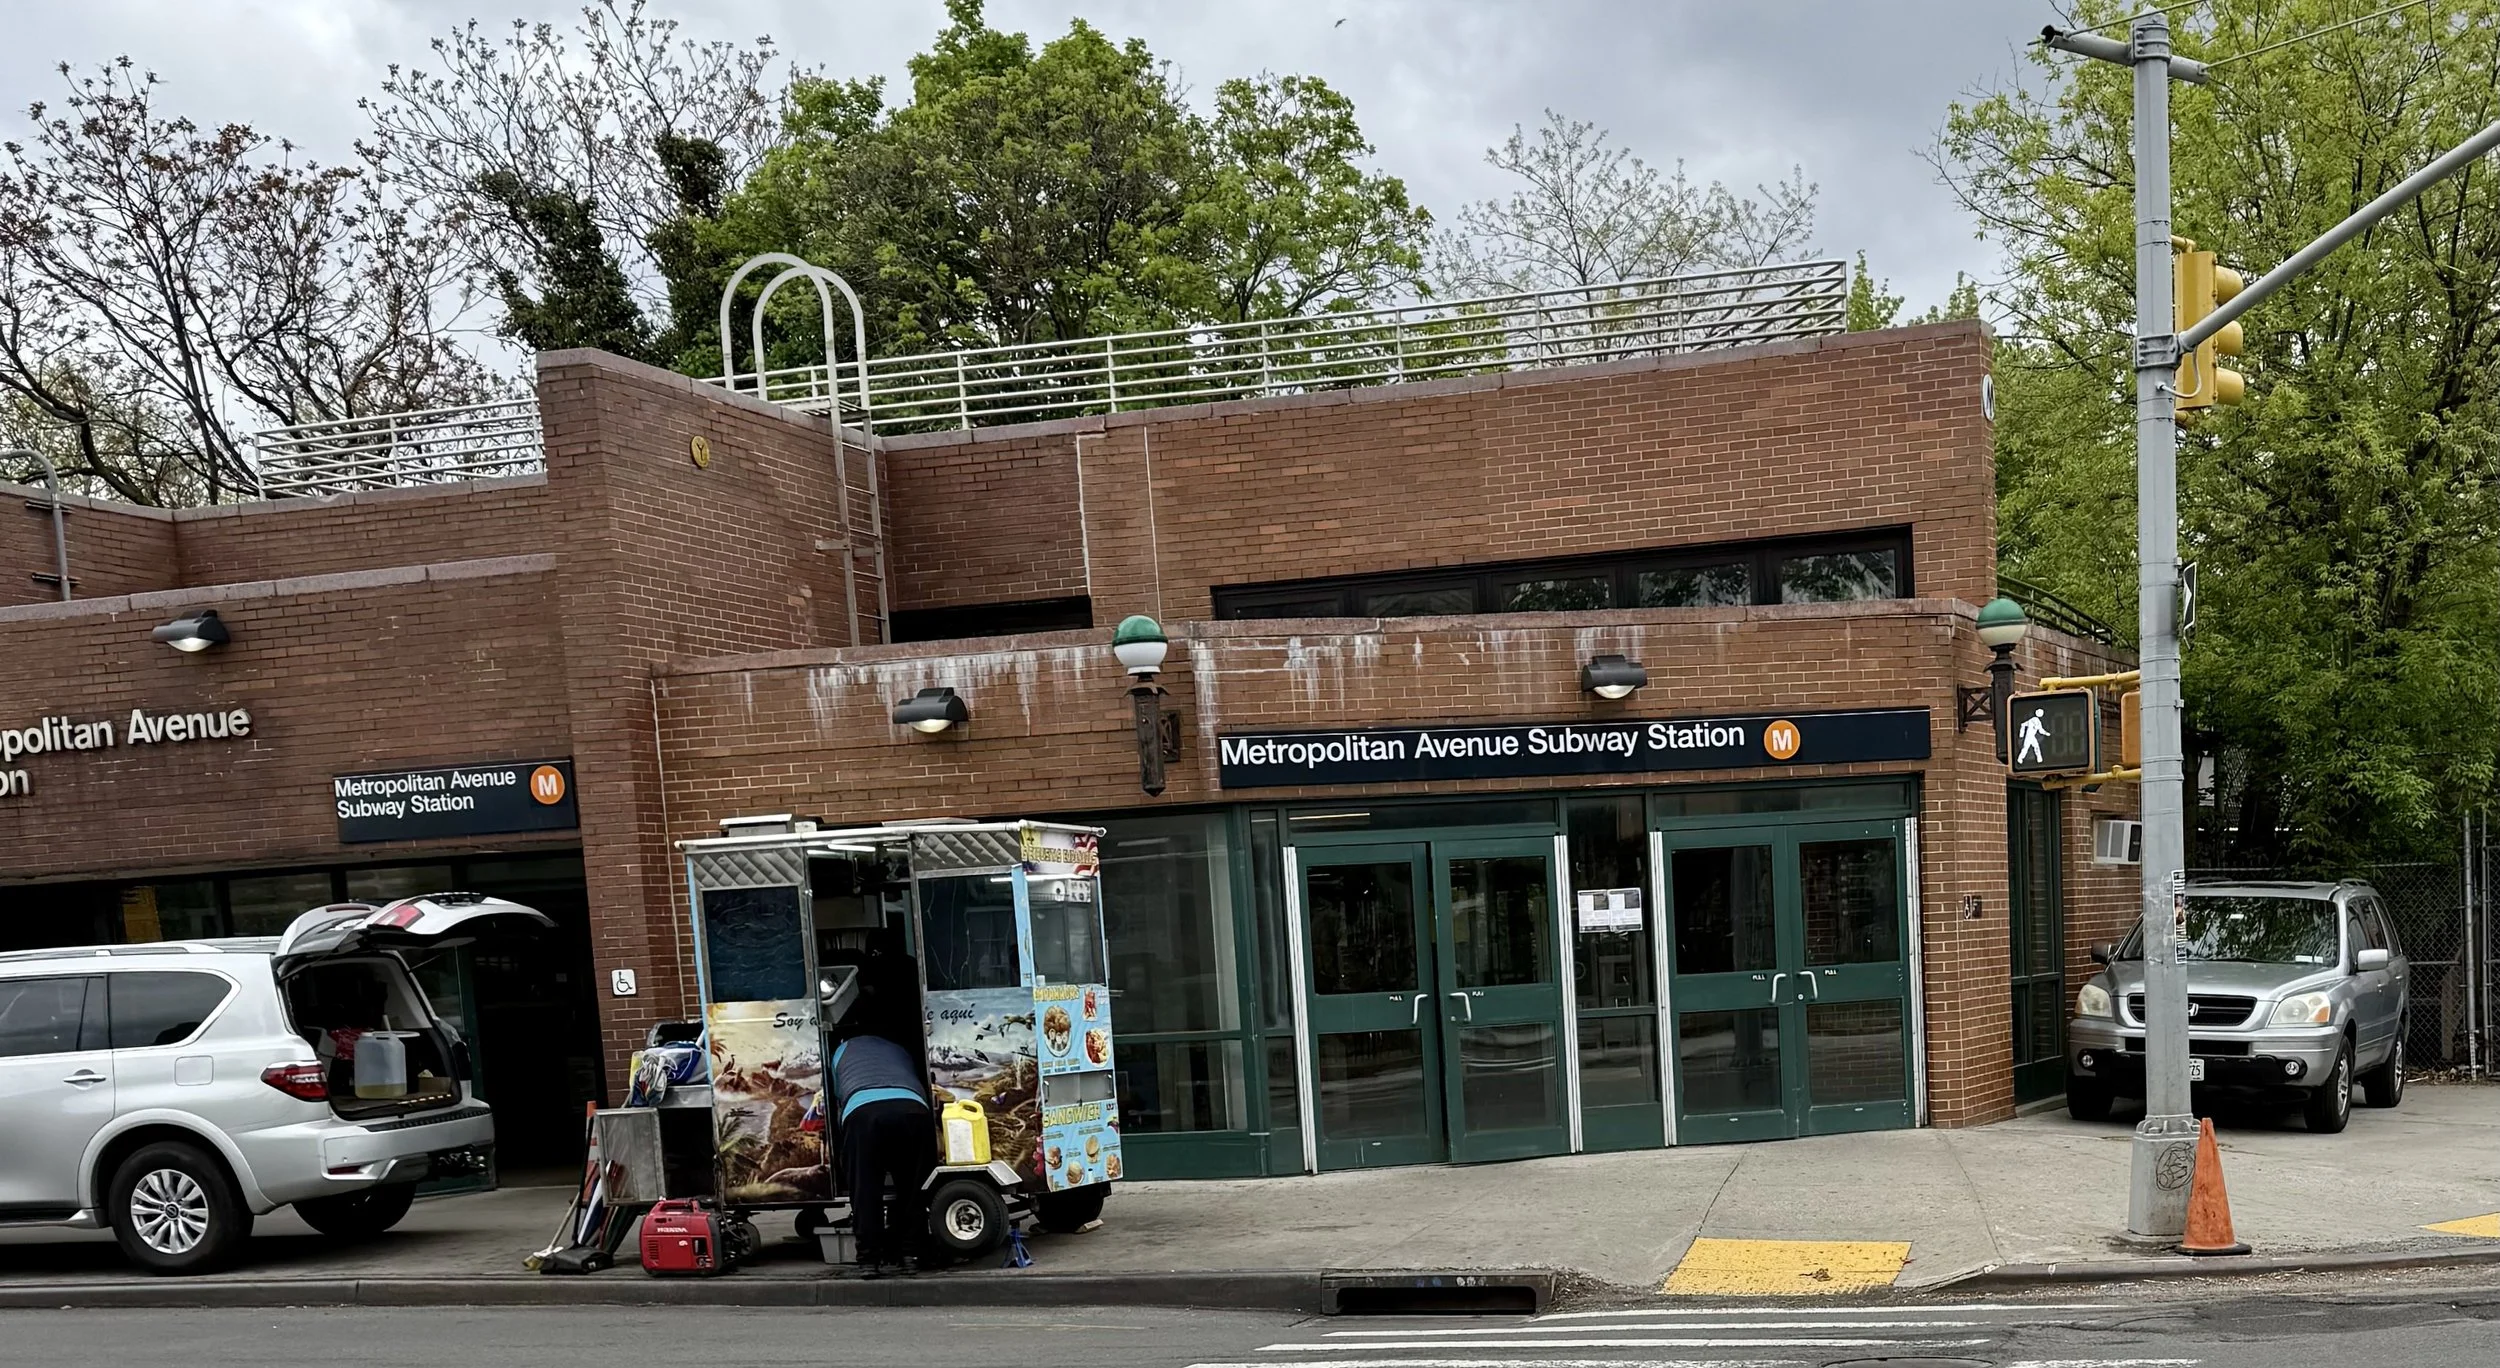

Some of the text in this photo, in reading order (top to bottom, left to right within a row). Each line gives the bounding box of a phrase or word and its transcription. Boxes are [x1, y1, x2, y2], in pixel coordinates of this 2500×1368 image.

[0, 708, 251, 762] politan Avenue
[1221, 735, 1405, 769] Metropolitan
[1414, 732, 1519, 760] Avenue
[1528, 727, 1639, 757] Subway
[1648, 722, 1745, 750] Station
[334, 773, 446, 798] Metropolitan
[450, 770, 517, 790] Avenue
[337, 794, 474, 819] Subway Station
[773, 1011, 801, 1031] Soy
[940, 1003, 976, 1026] aquí
[657, 1226, 689, 1234] HONDA
